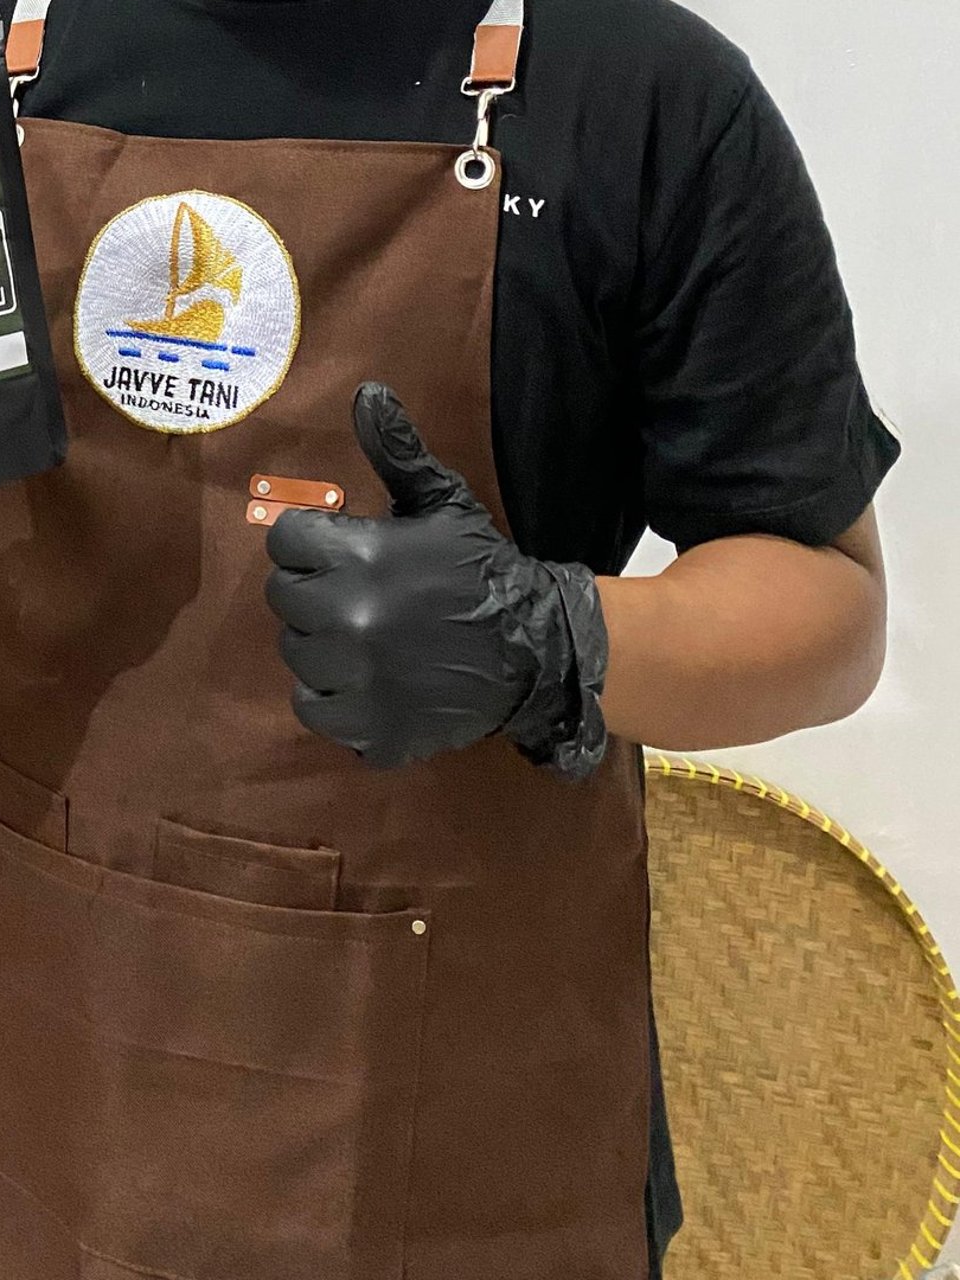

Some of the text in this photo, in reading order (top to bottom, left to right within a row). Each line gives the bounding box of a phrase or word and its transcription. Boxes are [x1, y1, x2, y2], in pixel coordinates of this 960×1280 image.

[103, 366, 239, 410] JAVVE TANI
[120, 393, 210, 419] INDONESIA
